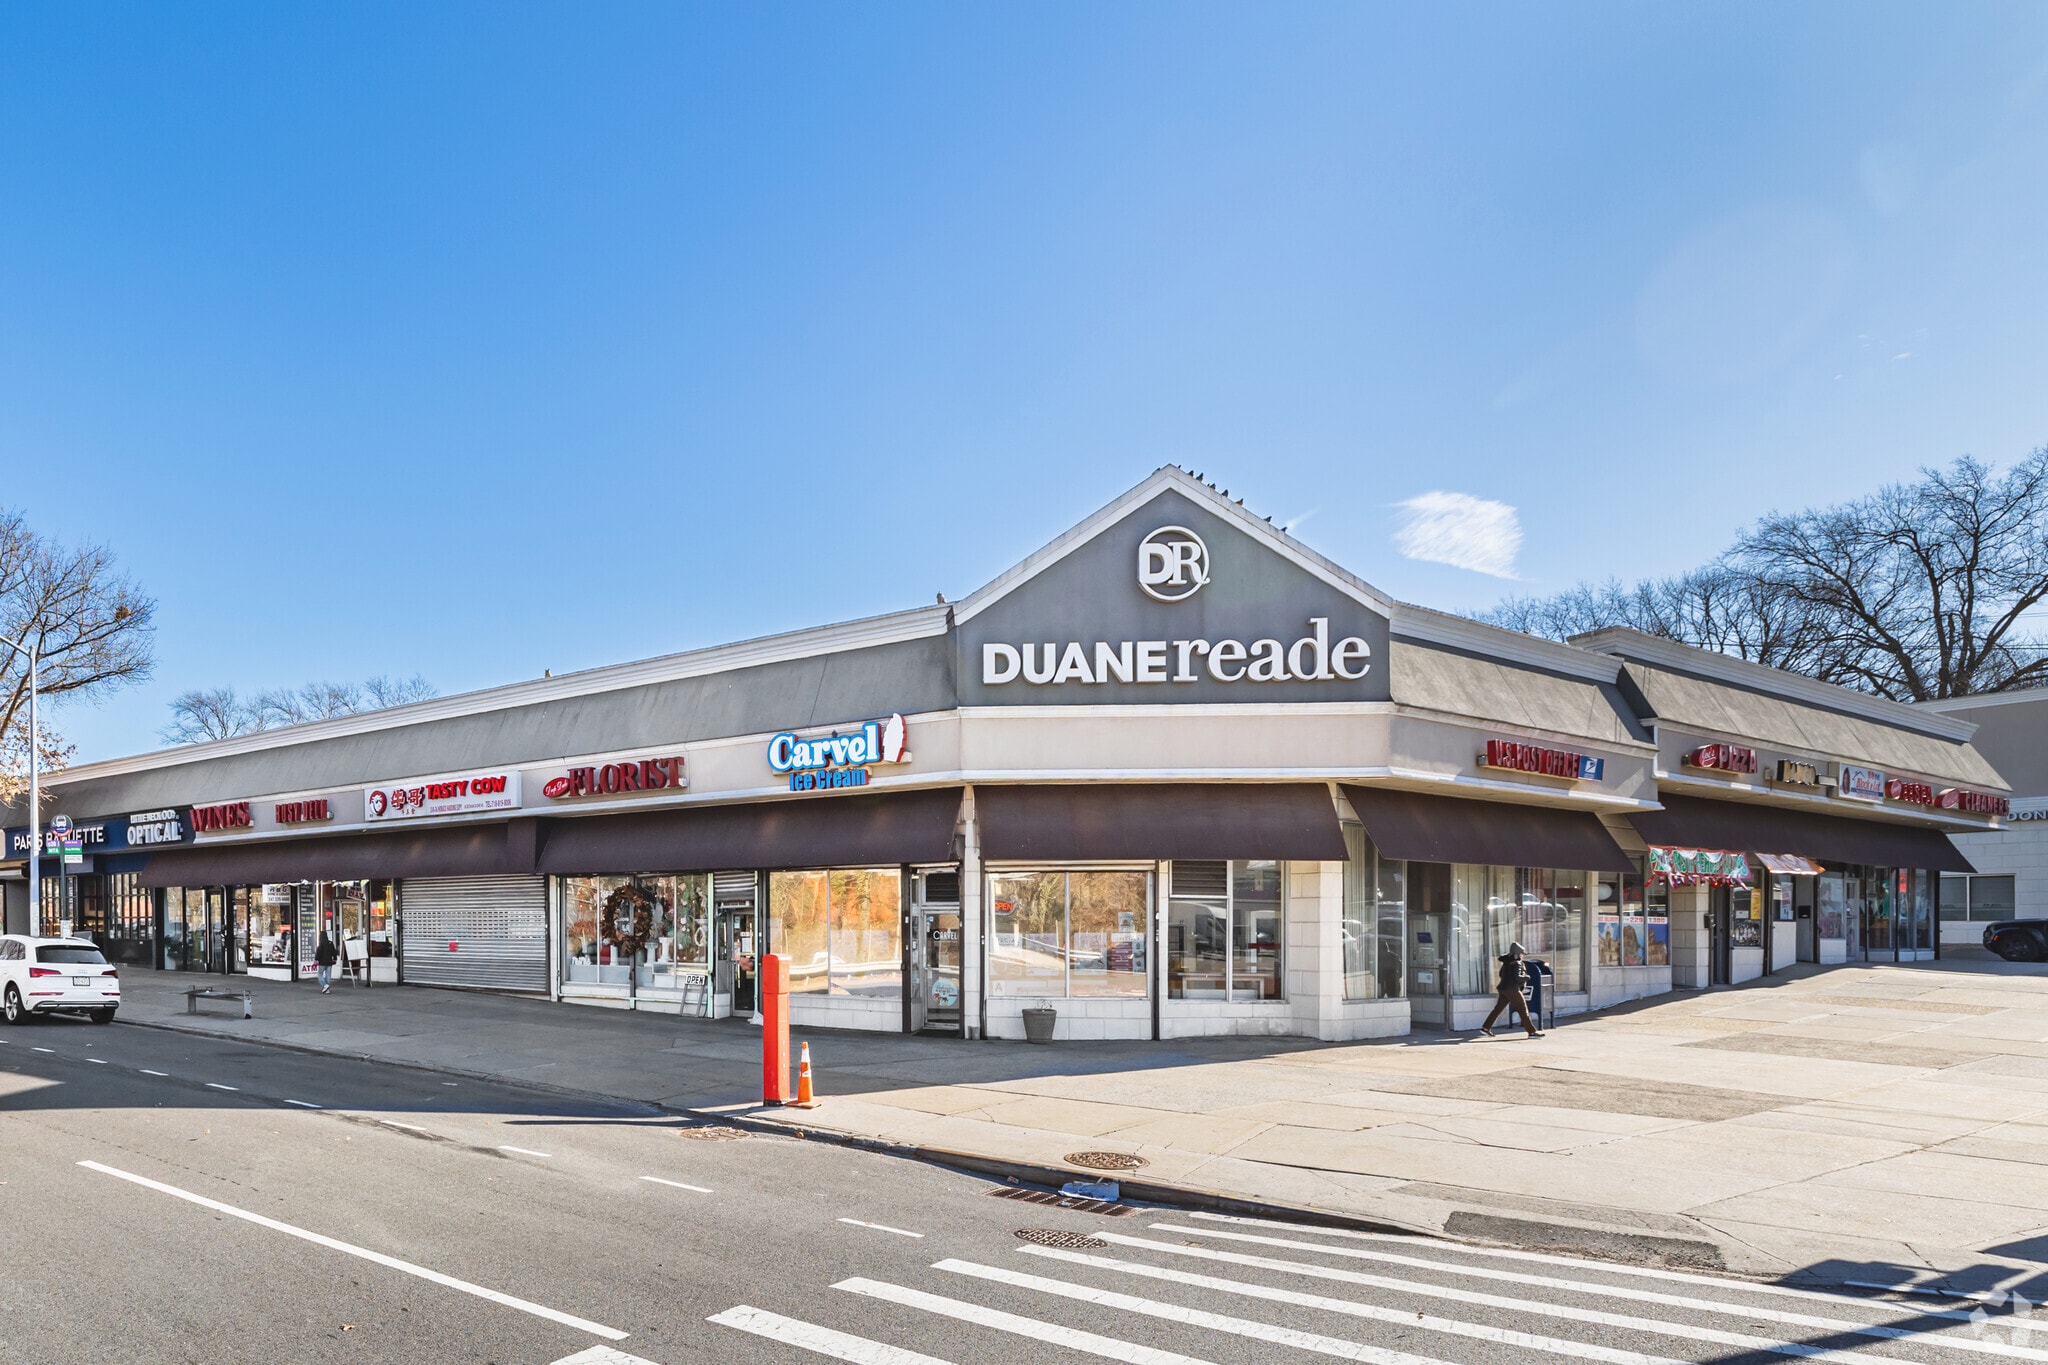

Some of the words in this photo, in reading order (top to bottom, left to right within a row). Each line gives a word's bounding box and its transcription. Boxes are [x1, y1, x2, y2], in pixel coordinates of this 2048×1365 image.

[1139, 541, 1210, 586] DR
[982, 640, 1168, 685] DUANE
[1172, 617, 1372, 684] reade
[768, 721, 883, 772] Carvel
[1718, 743, 1758, 774] PIZZA
[1515, 742, 1544, 773] POST
[1545, 749, 1580, 778] OFFICE
[426, 781, 469, 800] TASTY
[470, 776, 507, 795] COW
[567, 757, 685, 797] FLORIST
[789, 772, 813, 791] Ice
[816, 769, 868, 789] Cream
[190, 802, 250, 831] WINES
[14, 833, 43, 850] PARS
[46, 826, 104, 848] BUETTE
[127, 822, 182, 845] OPTICAL
[933, 928, 958, 941] CARVEL
[302, 964, 318, 972] ATM
[686, 975, 704, 984] OPEN
